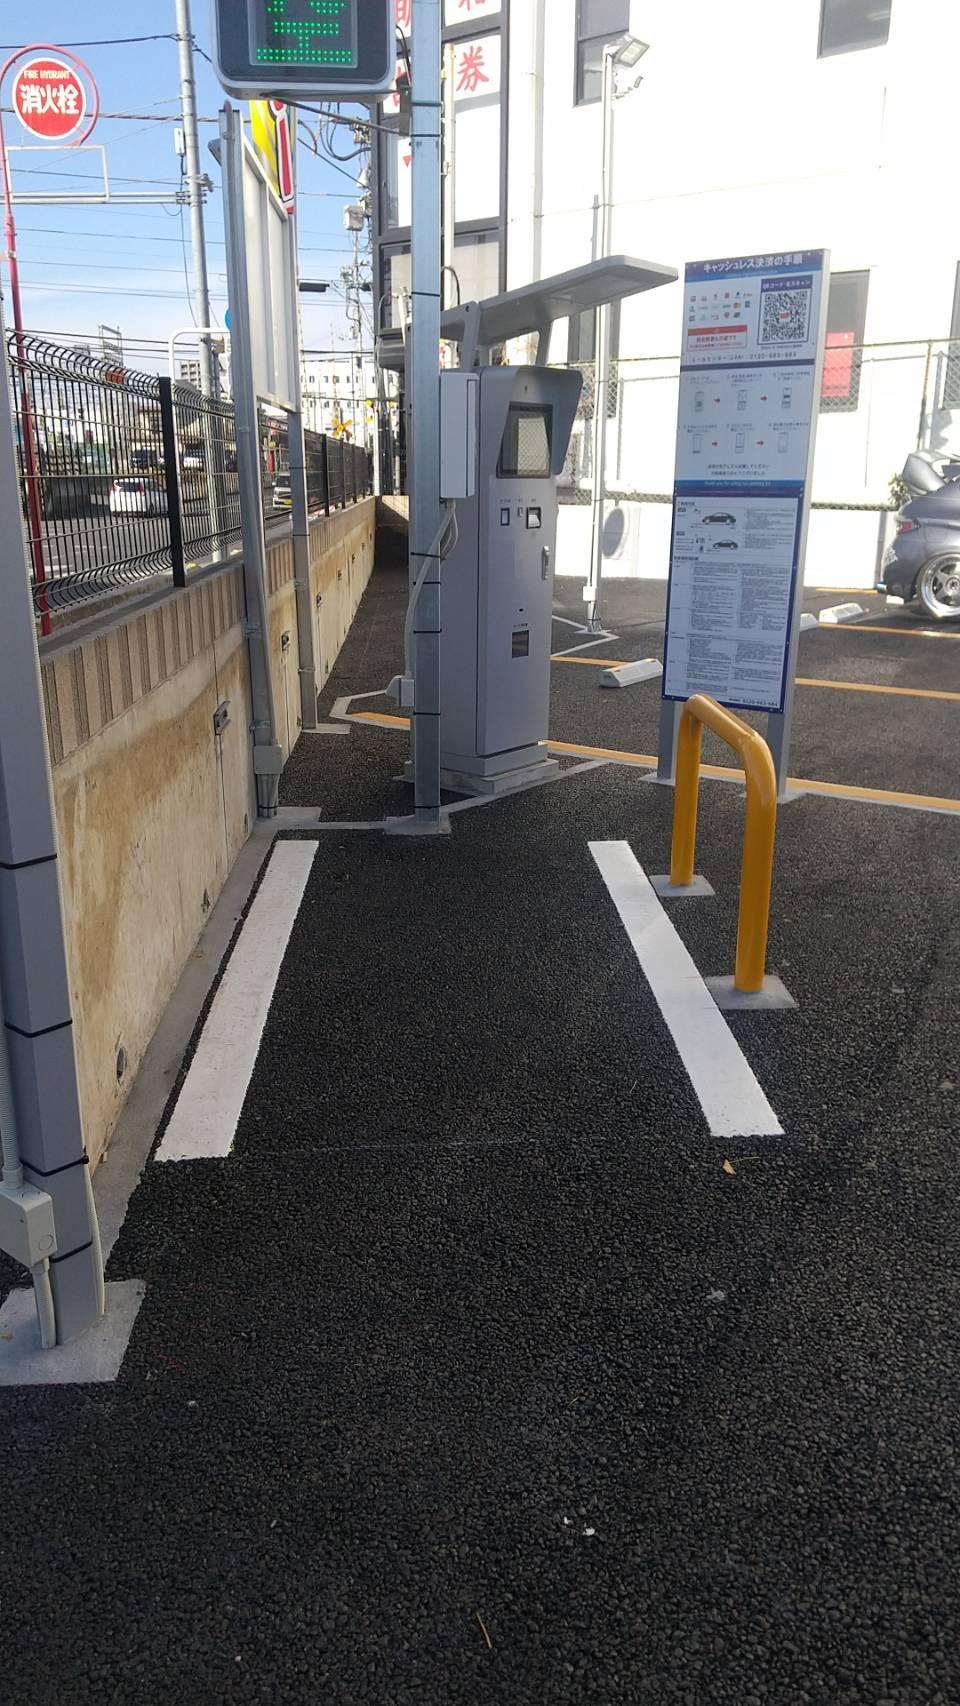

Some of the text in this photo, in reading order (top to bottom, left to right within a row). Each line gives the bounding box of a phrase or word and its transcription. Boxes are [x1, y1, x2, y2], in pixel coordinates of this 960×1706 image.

[23, 69, 70, 79] FIRE HYDRANT
[19, 84, 80, 114] 消火栓
